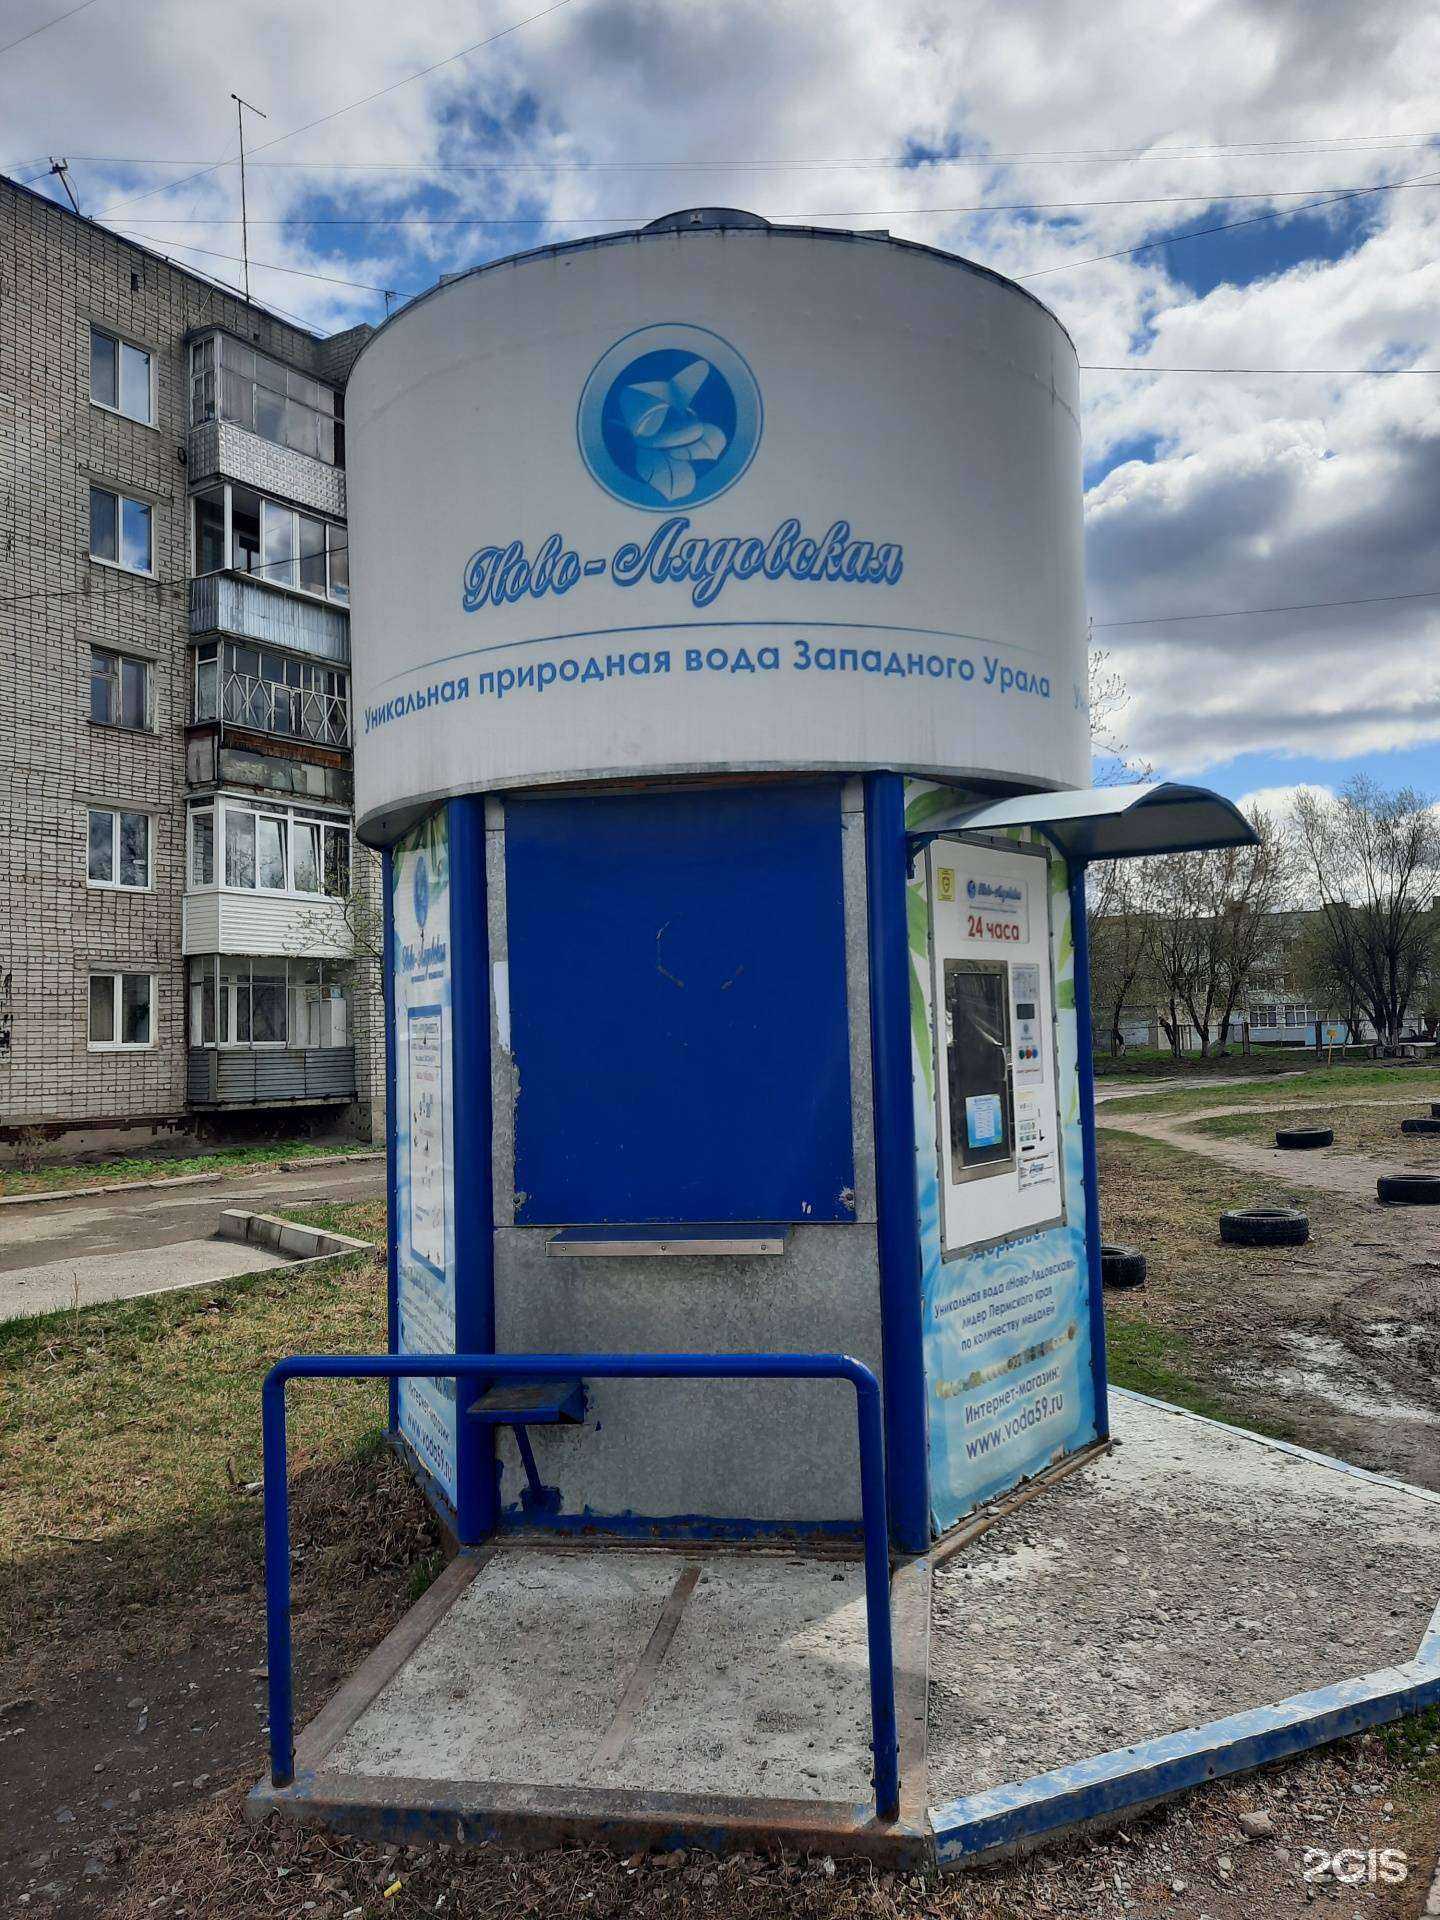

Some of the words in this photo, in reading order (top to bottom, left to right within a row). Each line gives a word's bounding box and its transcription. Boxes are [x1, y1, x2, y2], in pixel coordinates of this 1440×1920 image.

[462, 517, 904, 612] Ново-Лядовская
[364, 676, 470, 734] Уникальная
[479, 650, 671, 698] природная
[685, 646, 780, 674] вода
[792, 640, 975, 682] Западного
[983, 655, 1050, 699] Урала
[967, 915, 983, 938] 24
[986, 922, 1020, 941] часа
[934, 1290, 981, 1320] Уникальная
[983, 1283, 1004, 1300] вода
[962, 1309, 988, 1330] лидер
[989, 1293, 1034, 1318] Пермского
[961, 1338, 972, 1352] по
[973, 1317, 1020, 1345] количеству
[965, 1366, 1061, 1425] Интернет-магазин:
[966, 1394, 1064, 1460] www.voda59.ru
